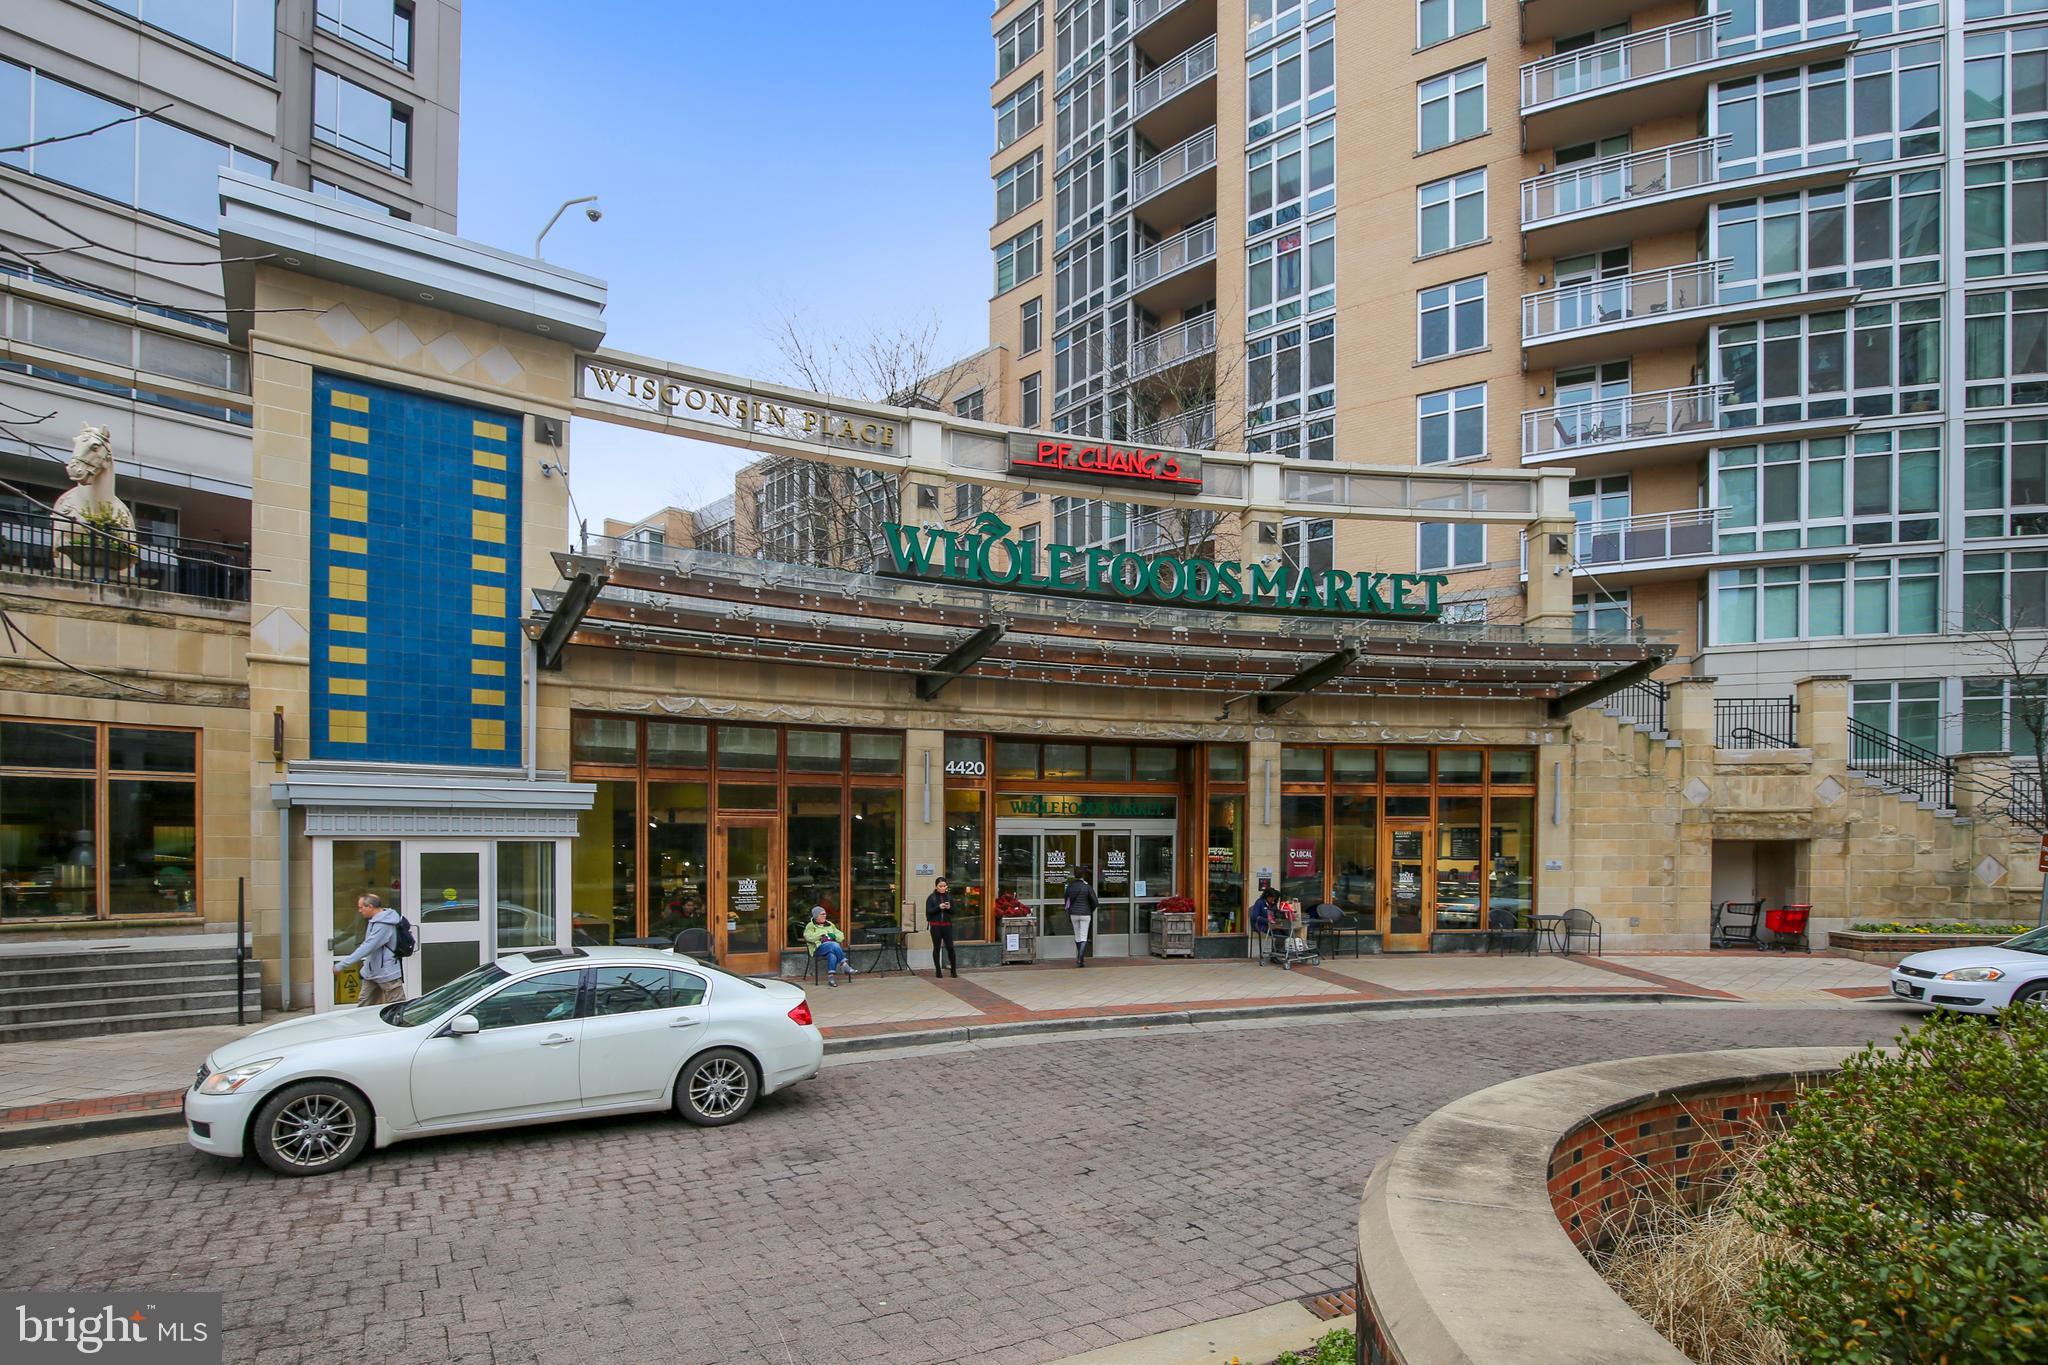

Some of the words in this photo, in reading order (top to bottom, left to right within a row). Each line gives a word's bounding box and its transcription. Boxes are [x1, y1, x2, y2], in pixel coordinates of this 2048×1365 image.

[588, 365, 786, 428] WISCONSIN
[802, 411, 896, 447] PLACE
[1037, 441, 1073, 469] P.F.
[1077, 443, 1182, 479] CHANG'S
[879, 513, 1077, 589] WHOLE
[1084, 546, 1244, 602] FOODS
[1248, 562, 1449, 616] MARKET
[945, 760, 985, 775] 4420
[1010, 796, 1060, 815] WHOLE
[1296, 850, 1312, 858] LOCAL
